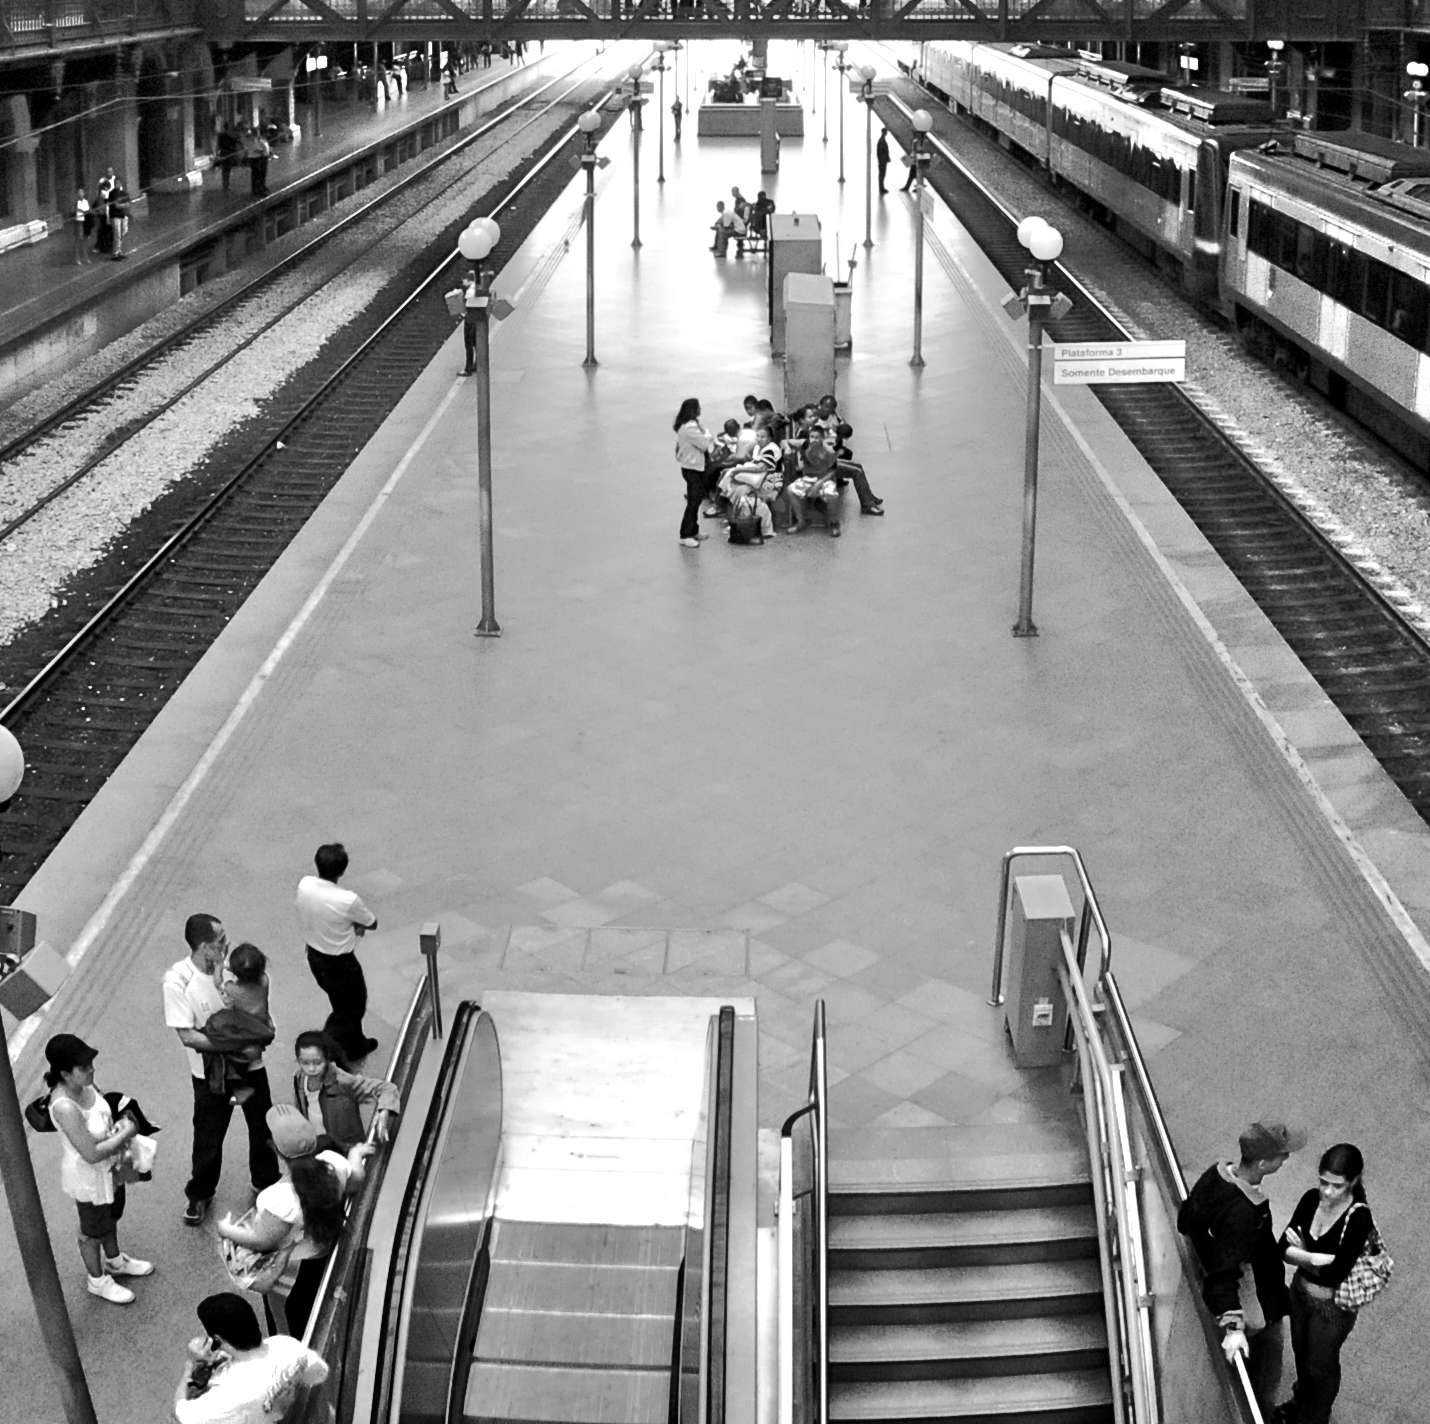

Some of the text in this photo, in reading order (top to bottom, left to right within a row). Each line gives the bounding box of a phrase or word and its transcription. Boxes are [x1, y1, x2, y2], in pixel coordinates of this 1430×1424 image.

[1061, 348, 1122, 357] Plataforma 3
[1061, 367, 1176, 377] Somente Desembarque
